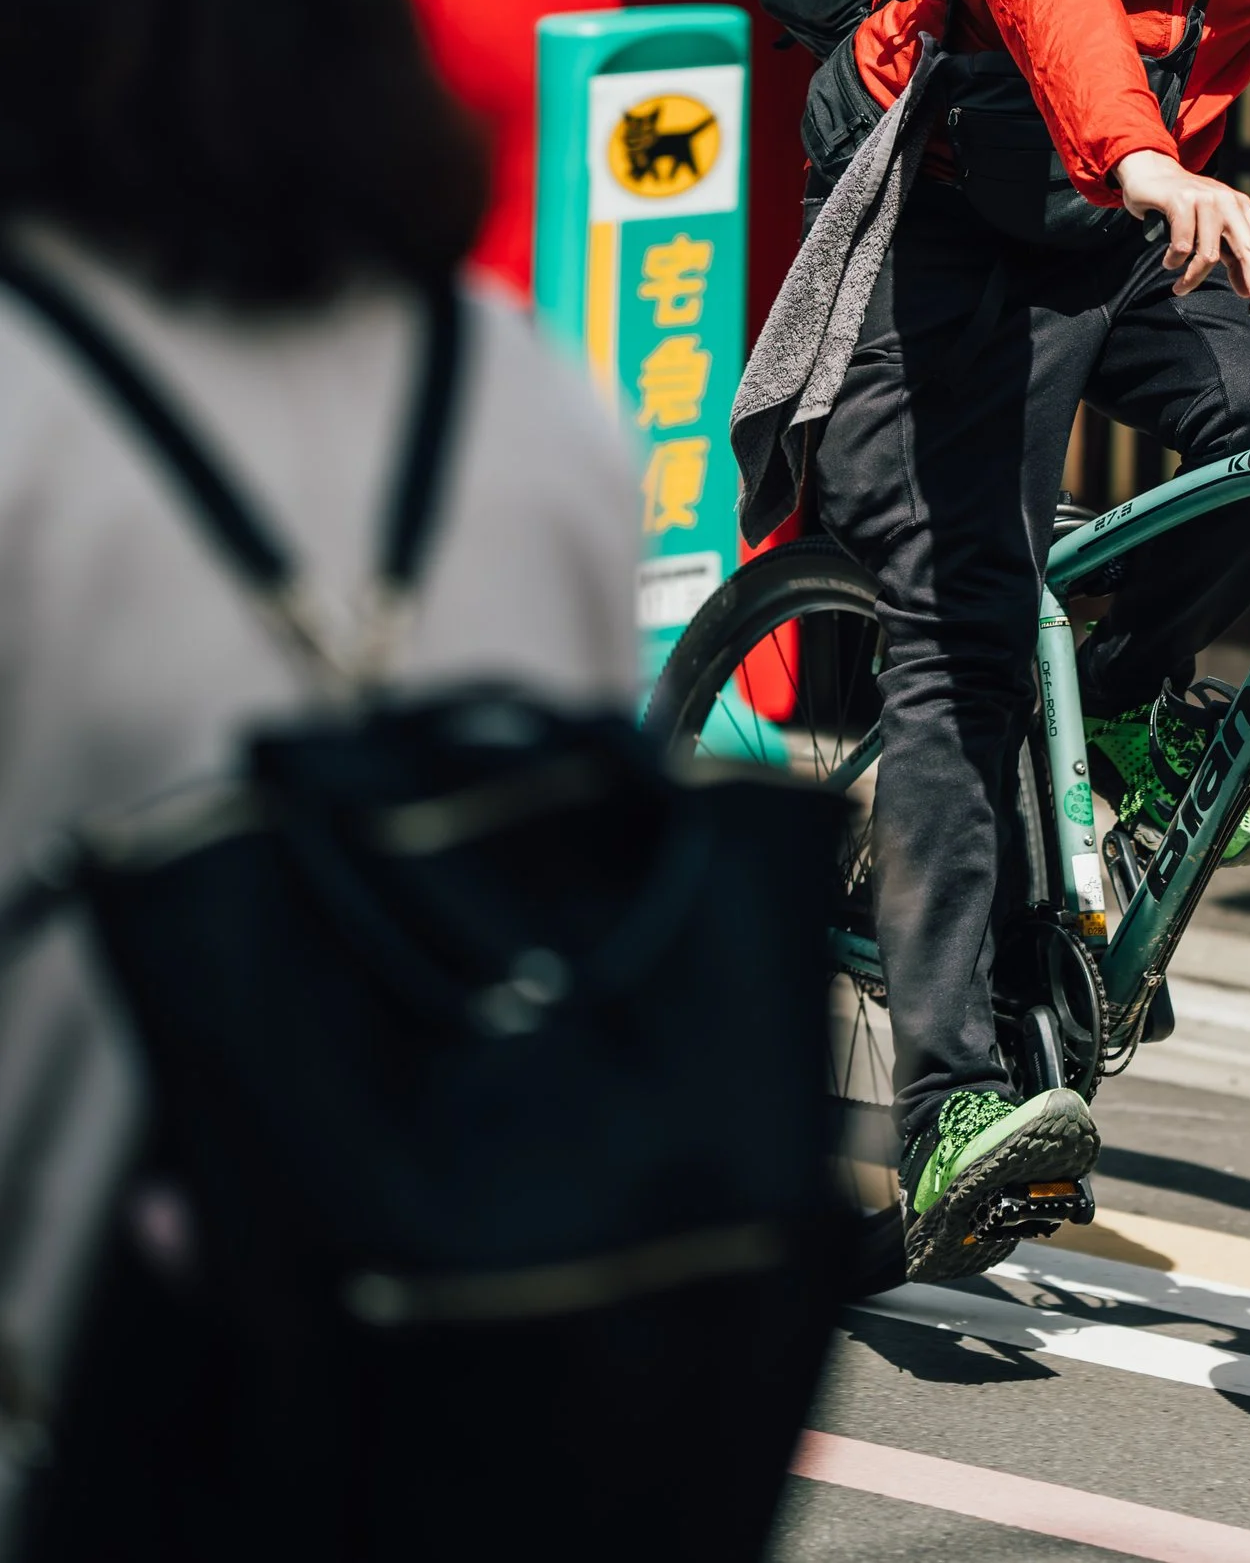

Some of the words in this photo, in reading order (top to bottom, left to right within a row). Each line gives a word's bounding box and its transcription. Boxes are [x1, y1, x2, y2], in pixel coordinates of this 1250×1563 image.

[636, 232, 714, 535] 宅急便
[1041, 620, 1063, 628] ITALIAN
[1041, 660, 1058, 738] OFF-ROAD
